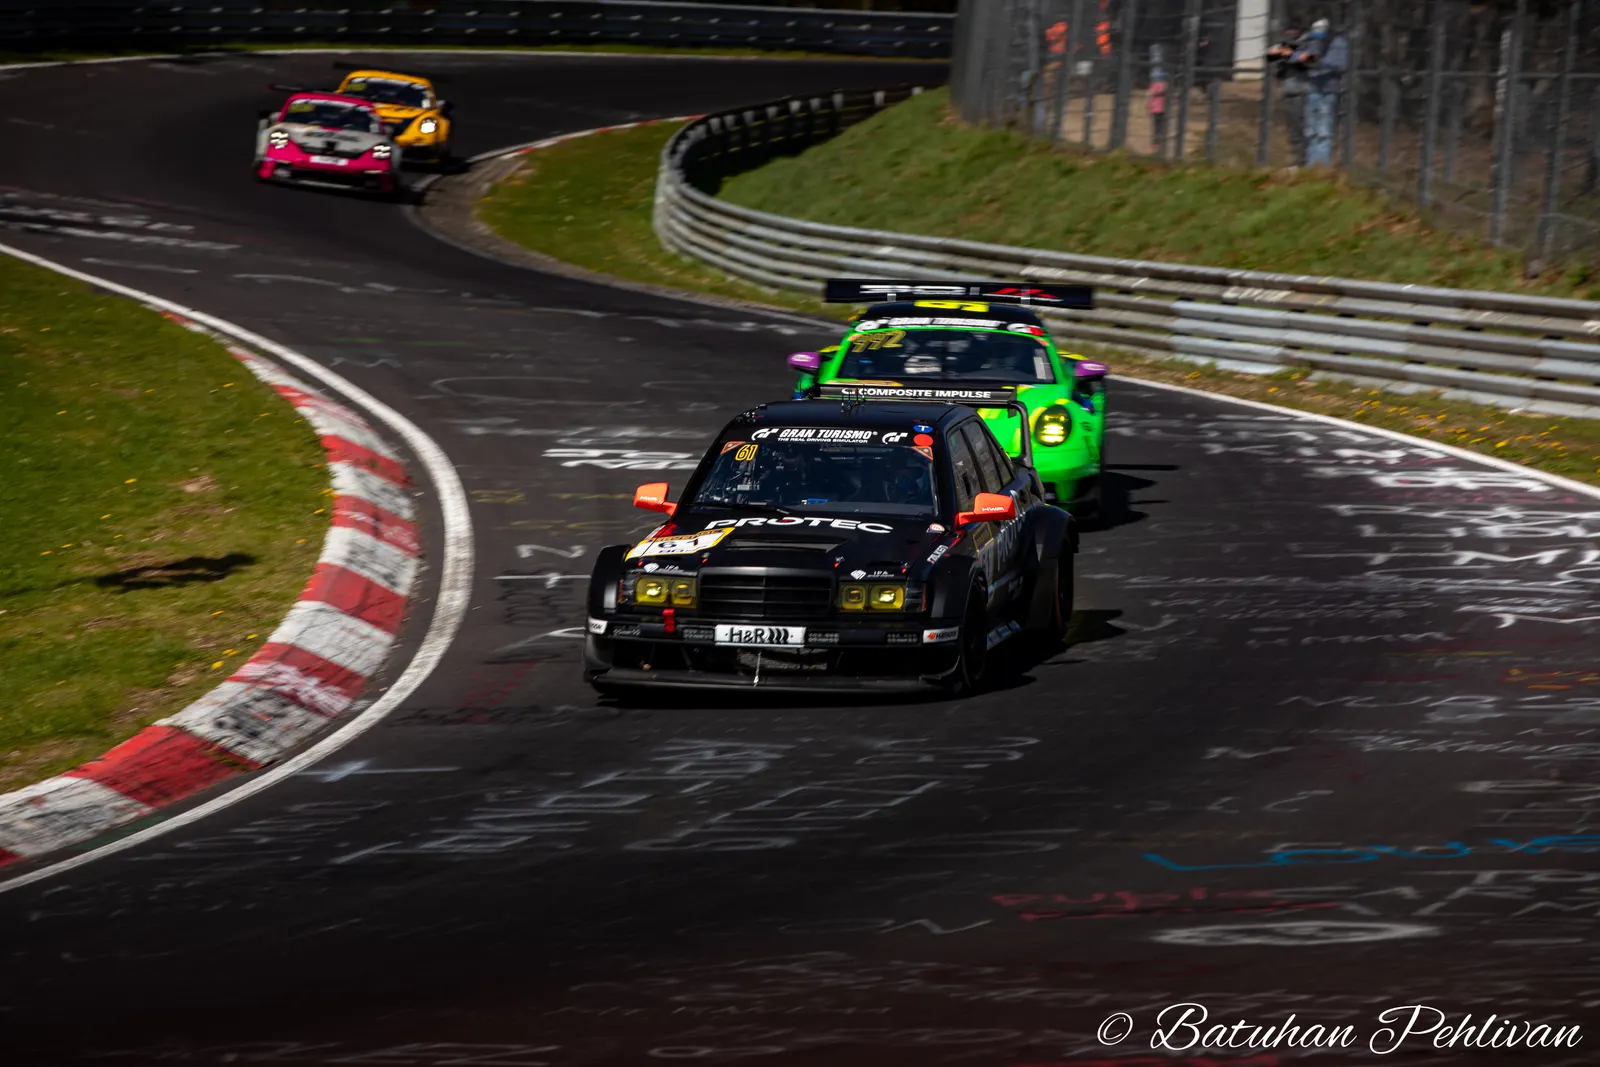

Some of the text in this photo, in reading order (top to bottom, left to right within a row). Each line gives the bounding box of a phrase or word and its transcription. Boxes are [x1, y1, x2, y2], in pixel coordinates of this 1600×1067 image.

[851, 330, 906, 353] 992
[858, 388, 932, 397] COMPOSITE
[935, 389, 992, 399] IMPULSE
[779, 428, 818, 438] GRAN
[818, 429, 873, 440] TURISMO
[735, 444, 758, 461] 61
[704, 517, 893, 533] PROTEC
[729, 627, 765, 644] H&R
